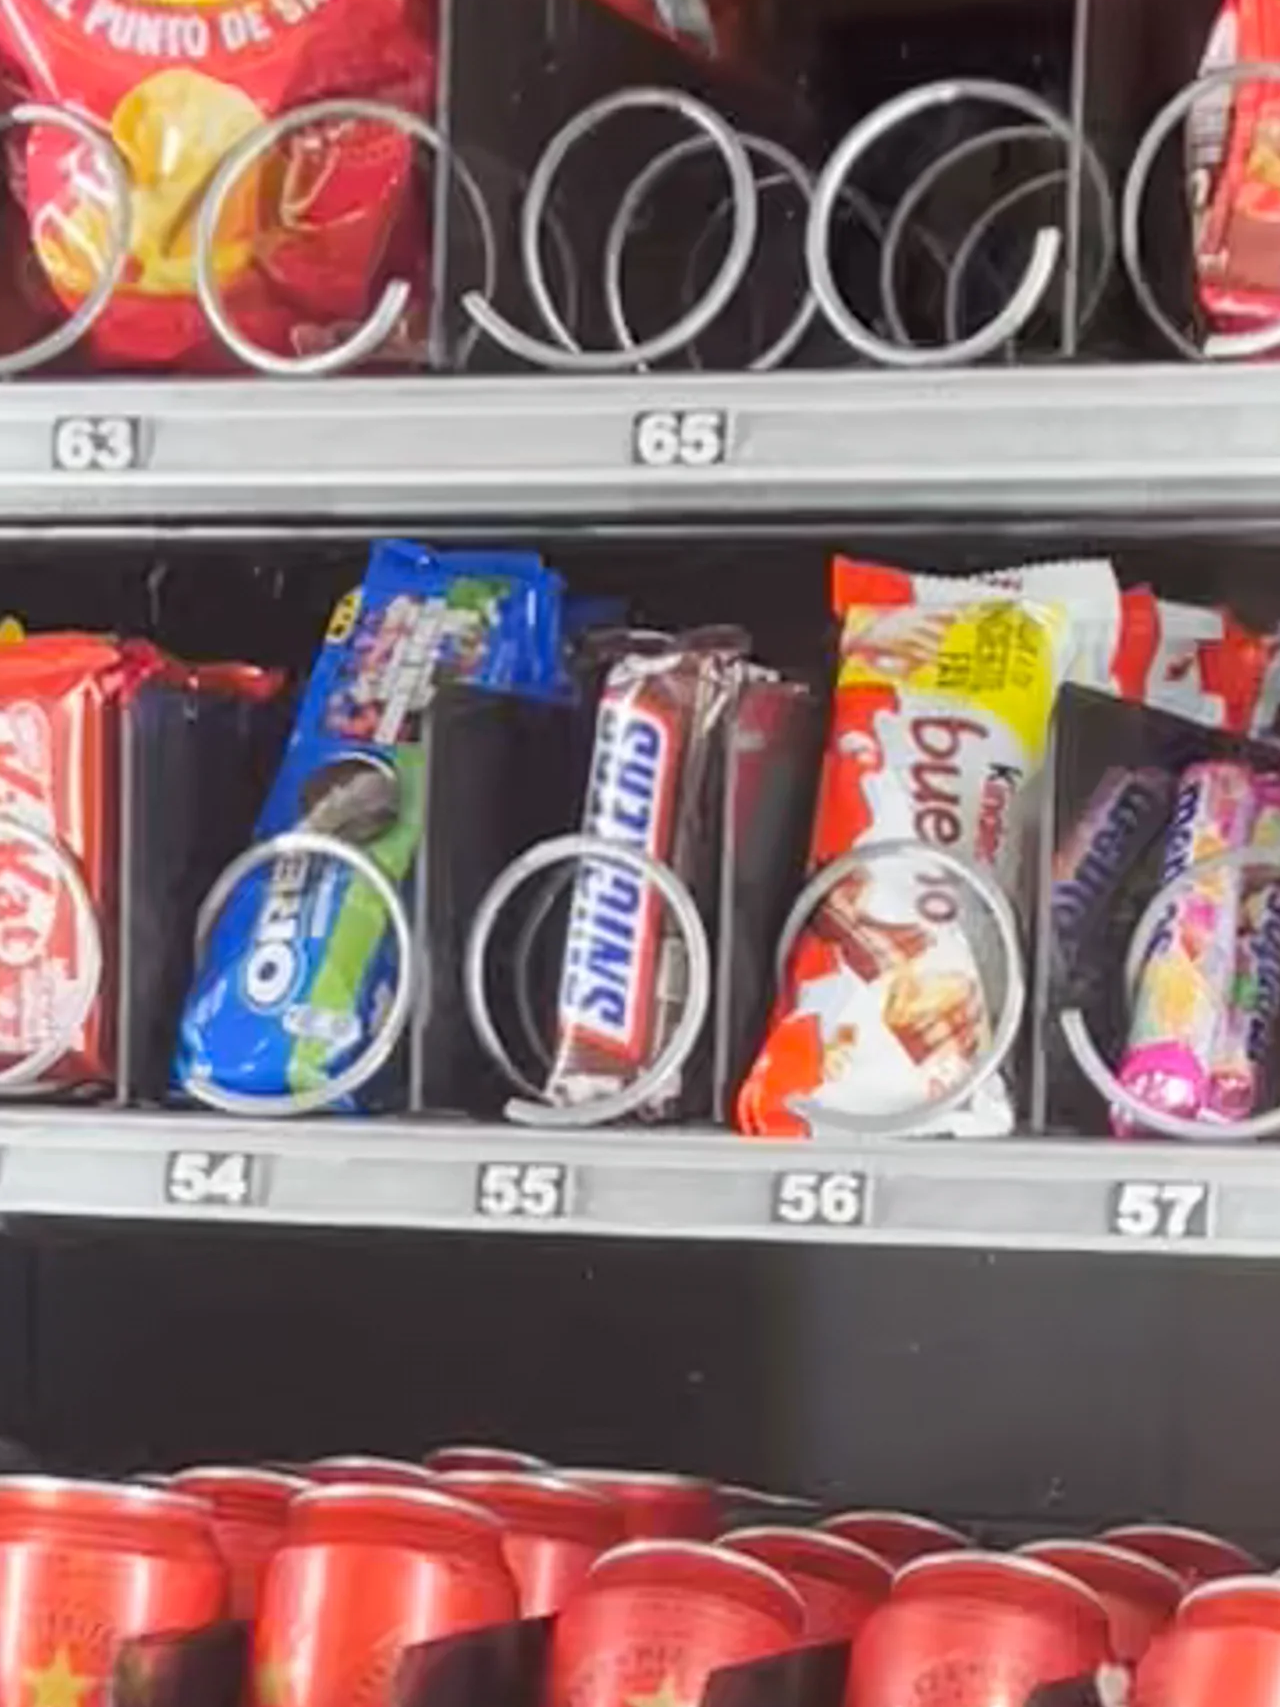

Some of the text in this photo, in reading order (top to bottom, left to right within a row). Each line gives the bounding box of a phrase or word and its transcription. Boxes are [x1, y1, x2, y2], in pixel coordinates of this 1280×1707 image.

[82, 0, 209, 57] PUNTO
[221, 0, 272, 49] DE
[56, 420, 132, 467] 63
[638, 415, 722, 465] 65
[580, 719, 660, 1028] SNICERS
[244, 849, 314, 1008] ORE
[167, 1152, 251, 1202] 54
[480, 1165, 560, 1214] 55
[779, 1176, 860, 1222] 56
[1116, 1186, 1206, 1233] 57
